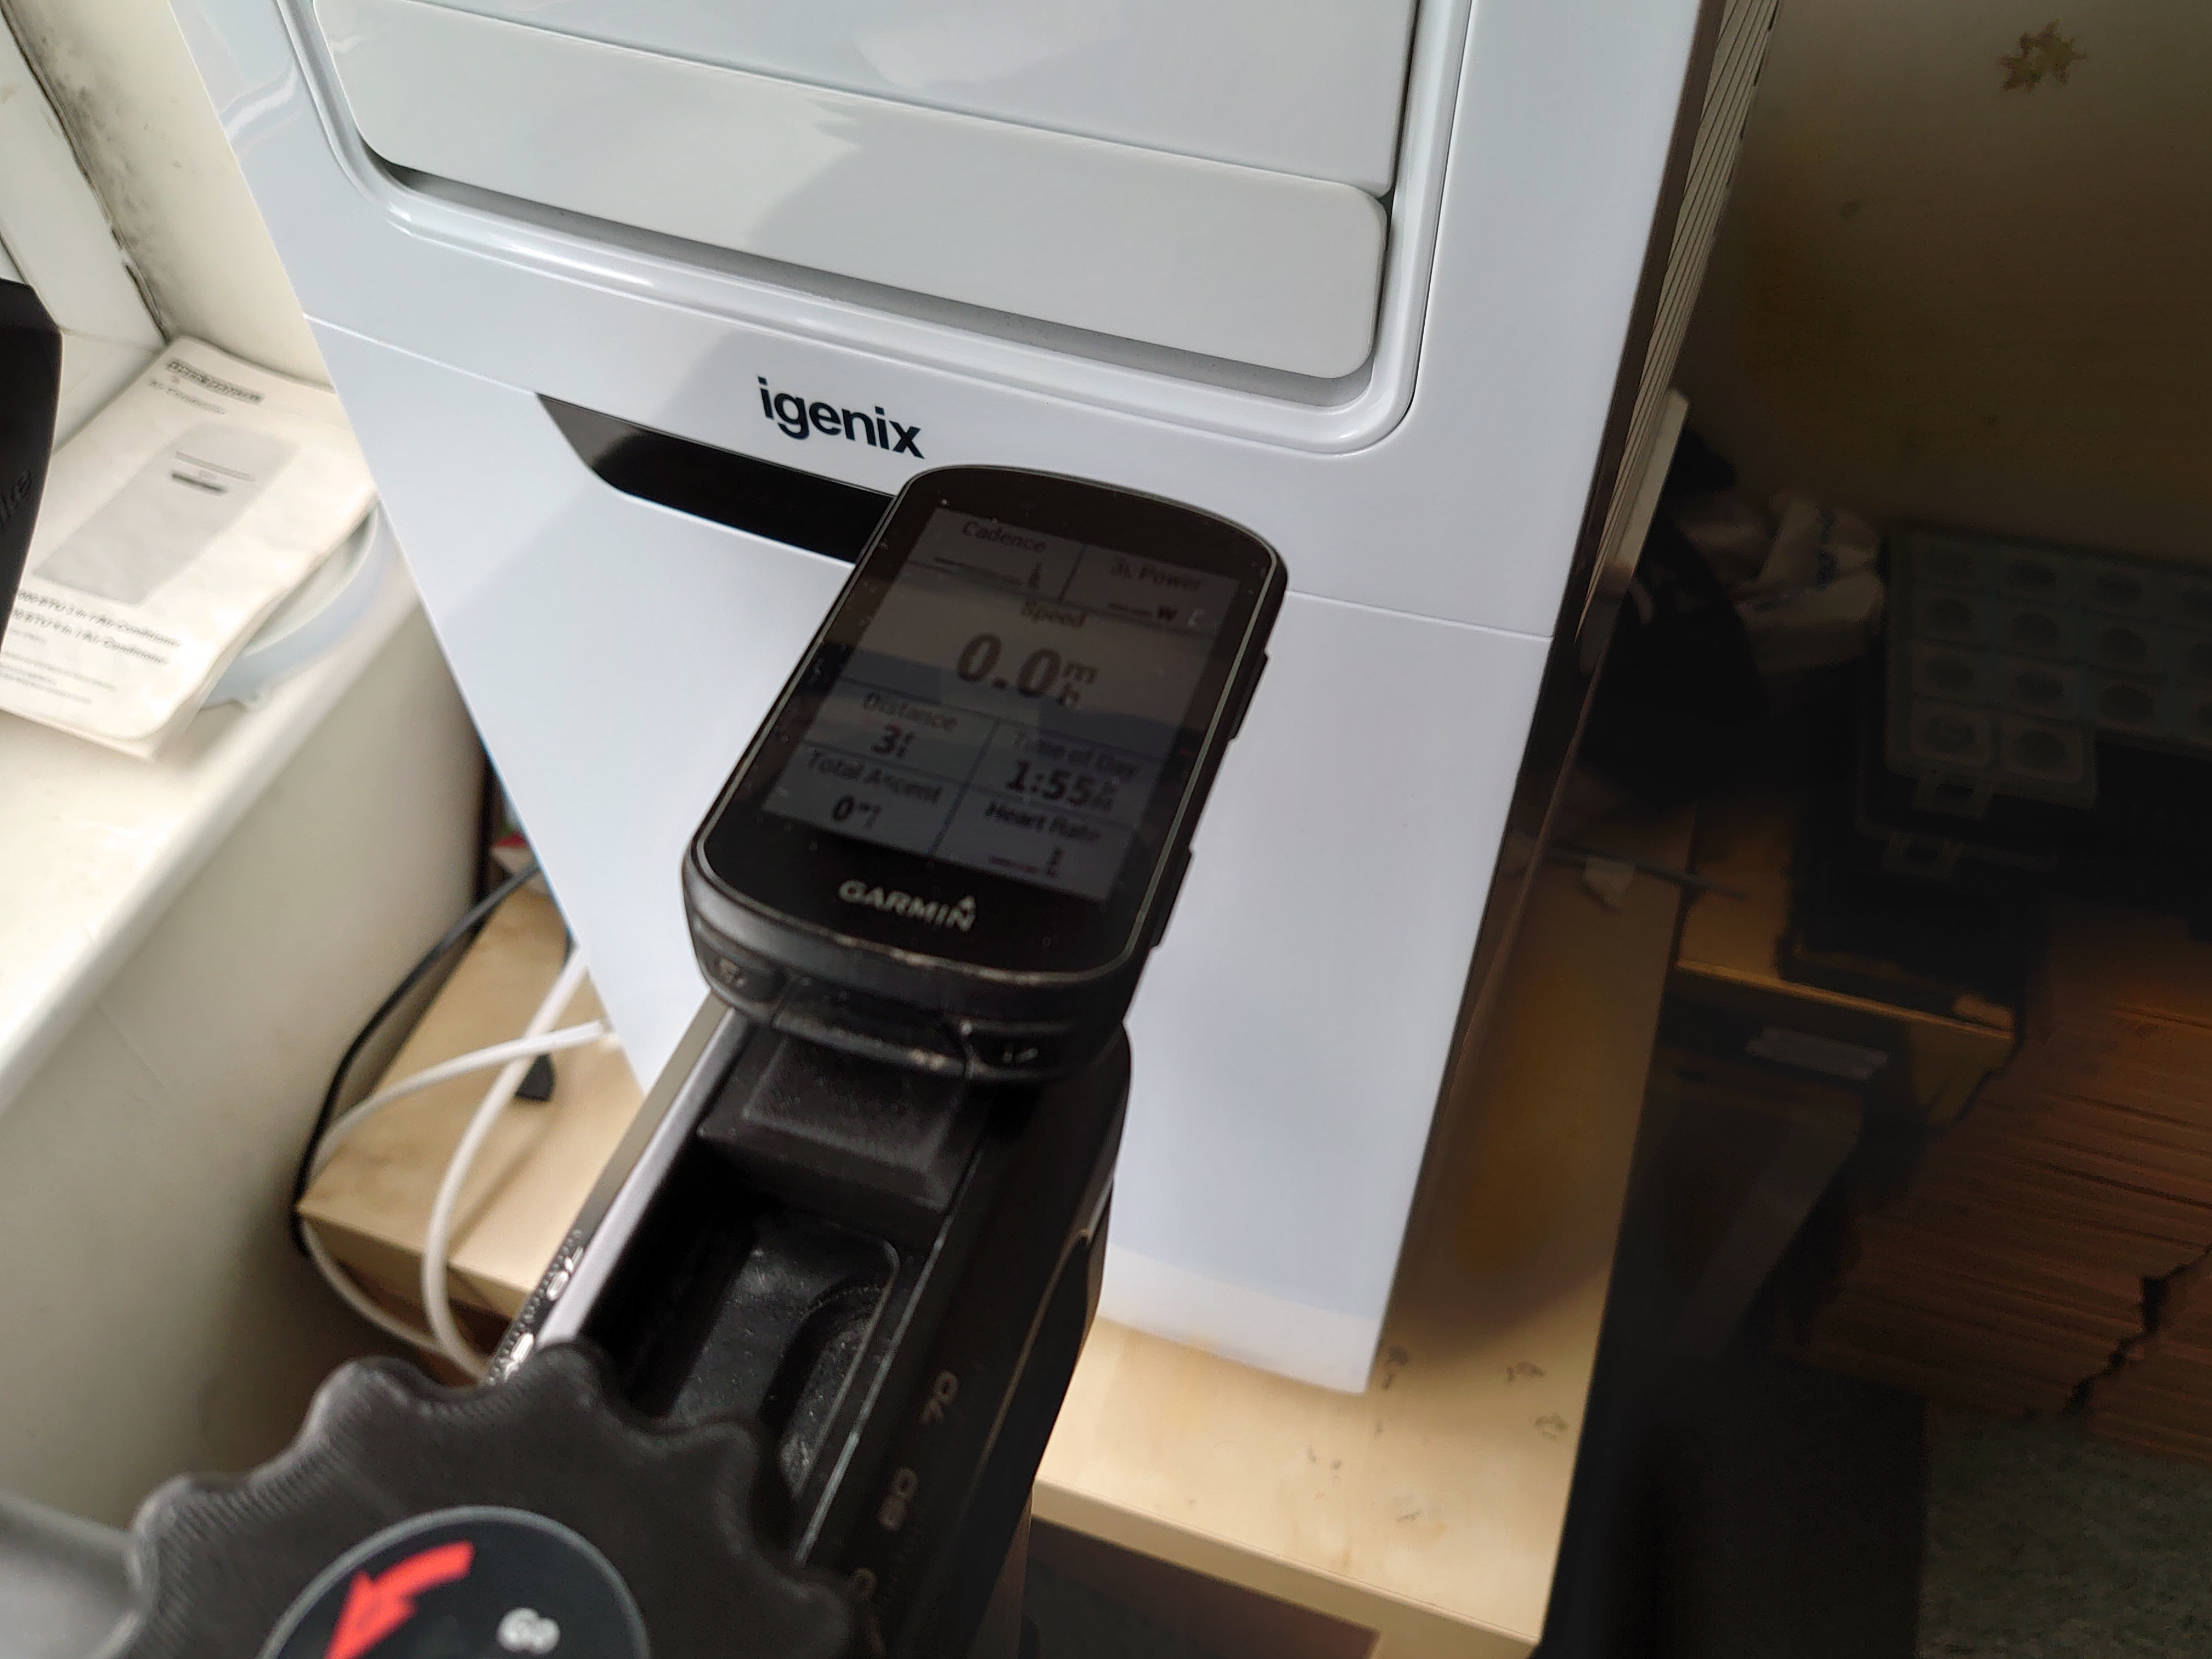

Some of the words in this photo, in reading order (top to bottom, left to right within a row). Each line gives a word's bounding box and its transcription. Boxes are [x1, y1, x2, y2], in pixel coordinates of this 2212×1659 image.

[758, 376, 925, 460] igenix
[962, 520, 1047, 554] Cadence
[1138, 563, 1203, 592] Power
[1022, 600, 1087, 630] Speed
[956, 633, 1062, 698] 0.0
[862, 690, 958, 732] Distance
[808, 749, 866, 781] Total
[863, 768, 943, 805] Ascent
[984, 800, 1047, 834] Heart
[1048, 815, 1102, 846] Rate
[837, 879, 977, 934] GARMIN
